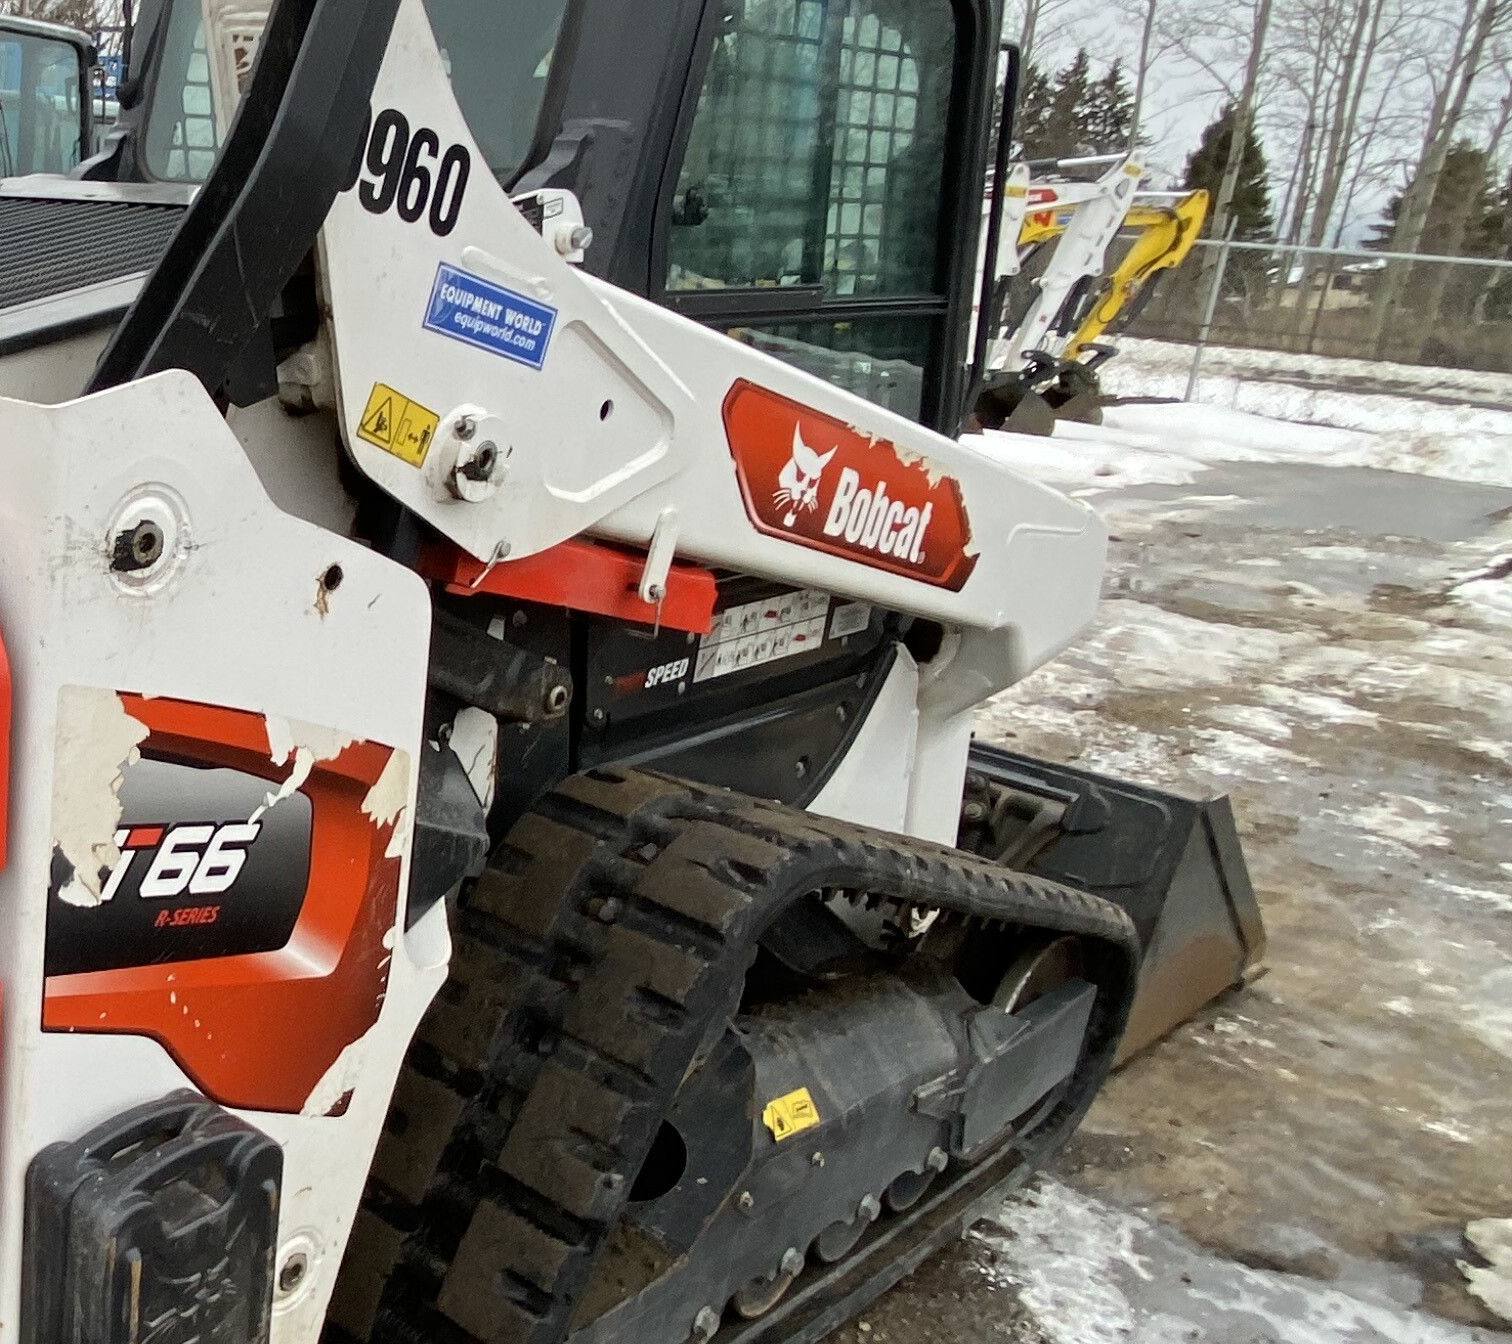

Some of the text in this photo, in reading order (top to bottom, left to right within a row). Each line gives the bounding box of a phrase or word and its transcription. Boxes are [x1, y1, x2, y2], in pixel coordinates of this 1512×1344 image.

[440, 283, 543, 337] EQUIPMENT WORLD
[454, 311, 537, 352] equipworld.com
[823, 467, 934, 564] Bobcat
[644, 657, 690, 689] SPEED
[154, 906, 221, 927] R-SERIES
